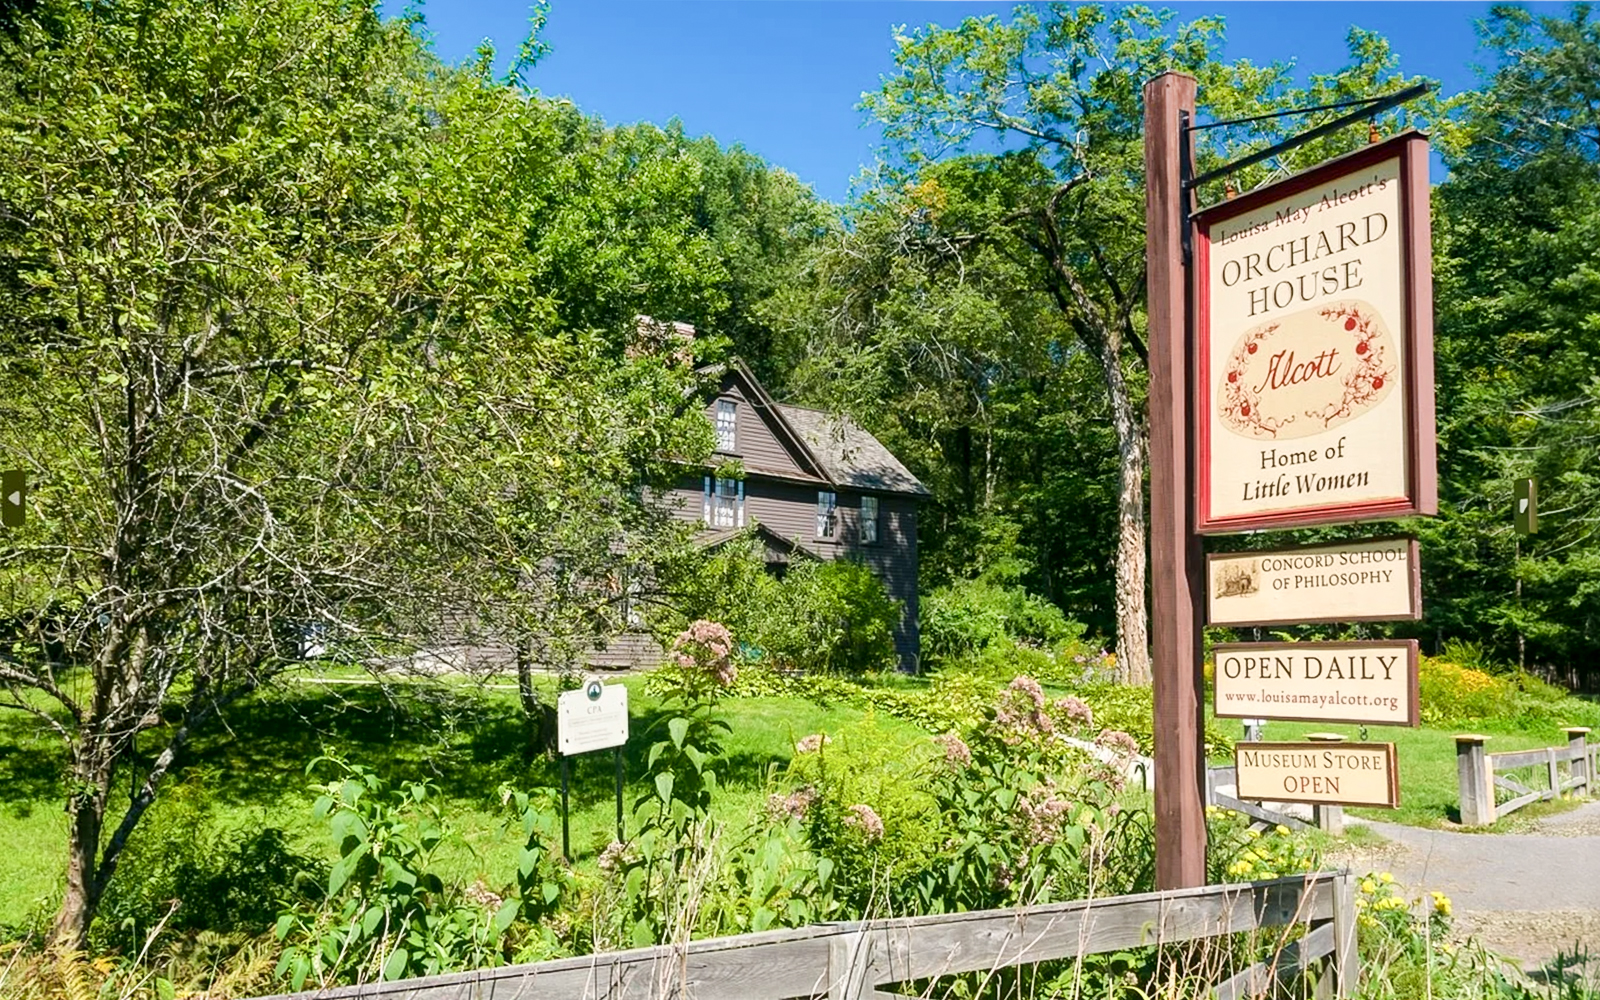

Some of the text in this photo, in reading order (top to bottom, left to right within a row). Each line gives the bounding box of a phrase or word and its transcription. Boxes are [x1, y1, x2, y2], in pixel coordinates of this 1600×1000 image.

[1220, 175, 1388, 246] Louisa May Alcott's
[1222, 212, 1388, 287] ORCHARD
[1247, 259, 1363, 317] HOUSE
[1252, 347, 1342, 394] Alcott
[1260, 436, 1346, 470] Home of
[1242, 471, 1370, 501] Little Women
[1261, 548, 1407, 573] CONCORD SCHOOL
[1272, 569, 1393, 591] OF PHILOSOPHY
[1224, 655, 1399, 681] OPEN DAILY
[1225, 689, 1399, 711] www.louisamayalcott.org
[1244, 751, 1382, 770] MUSEUM STORE
[1283, 775, 1341, 794] OPEN
